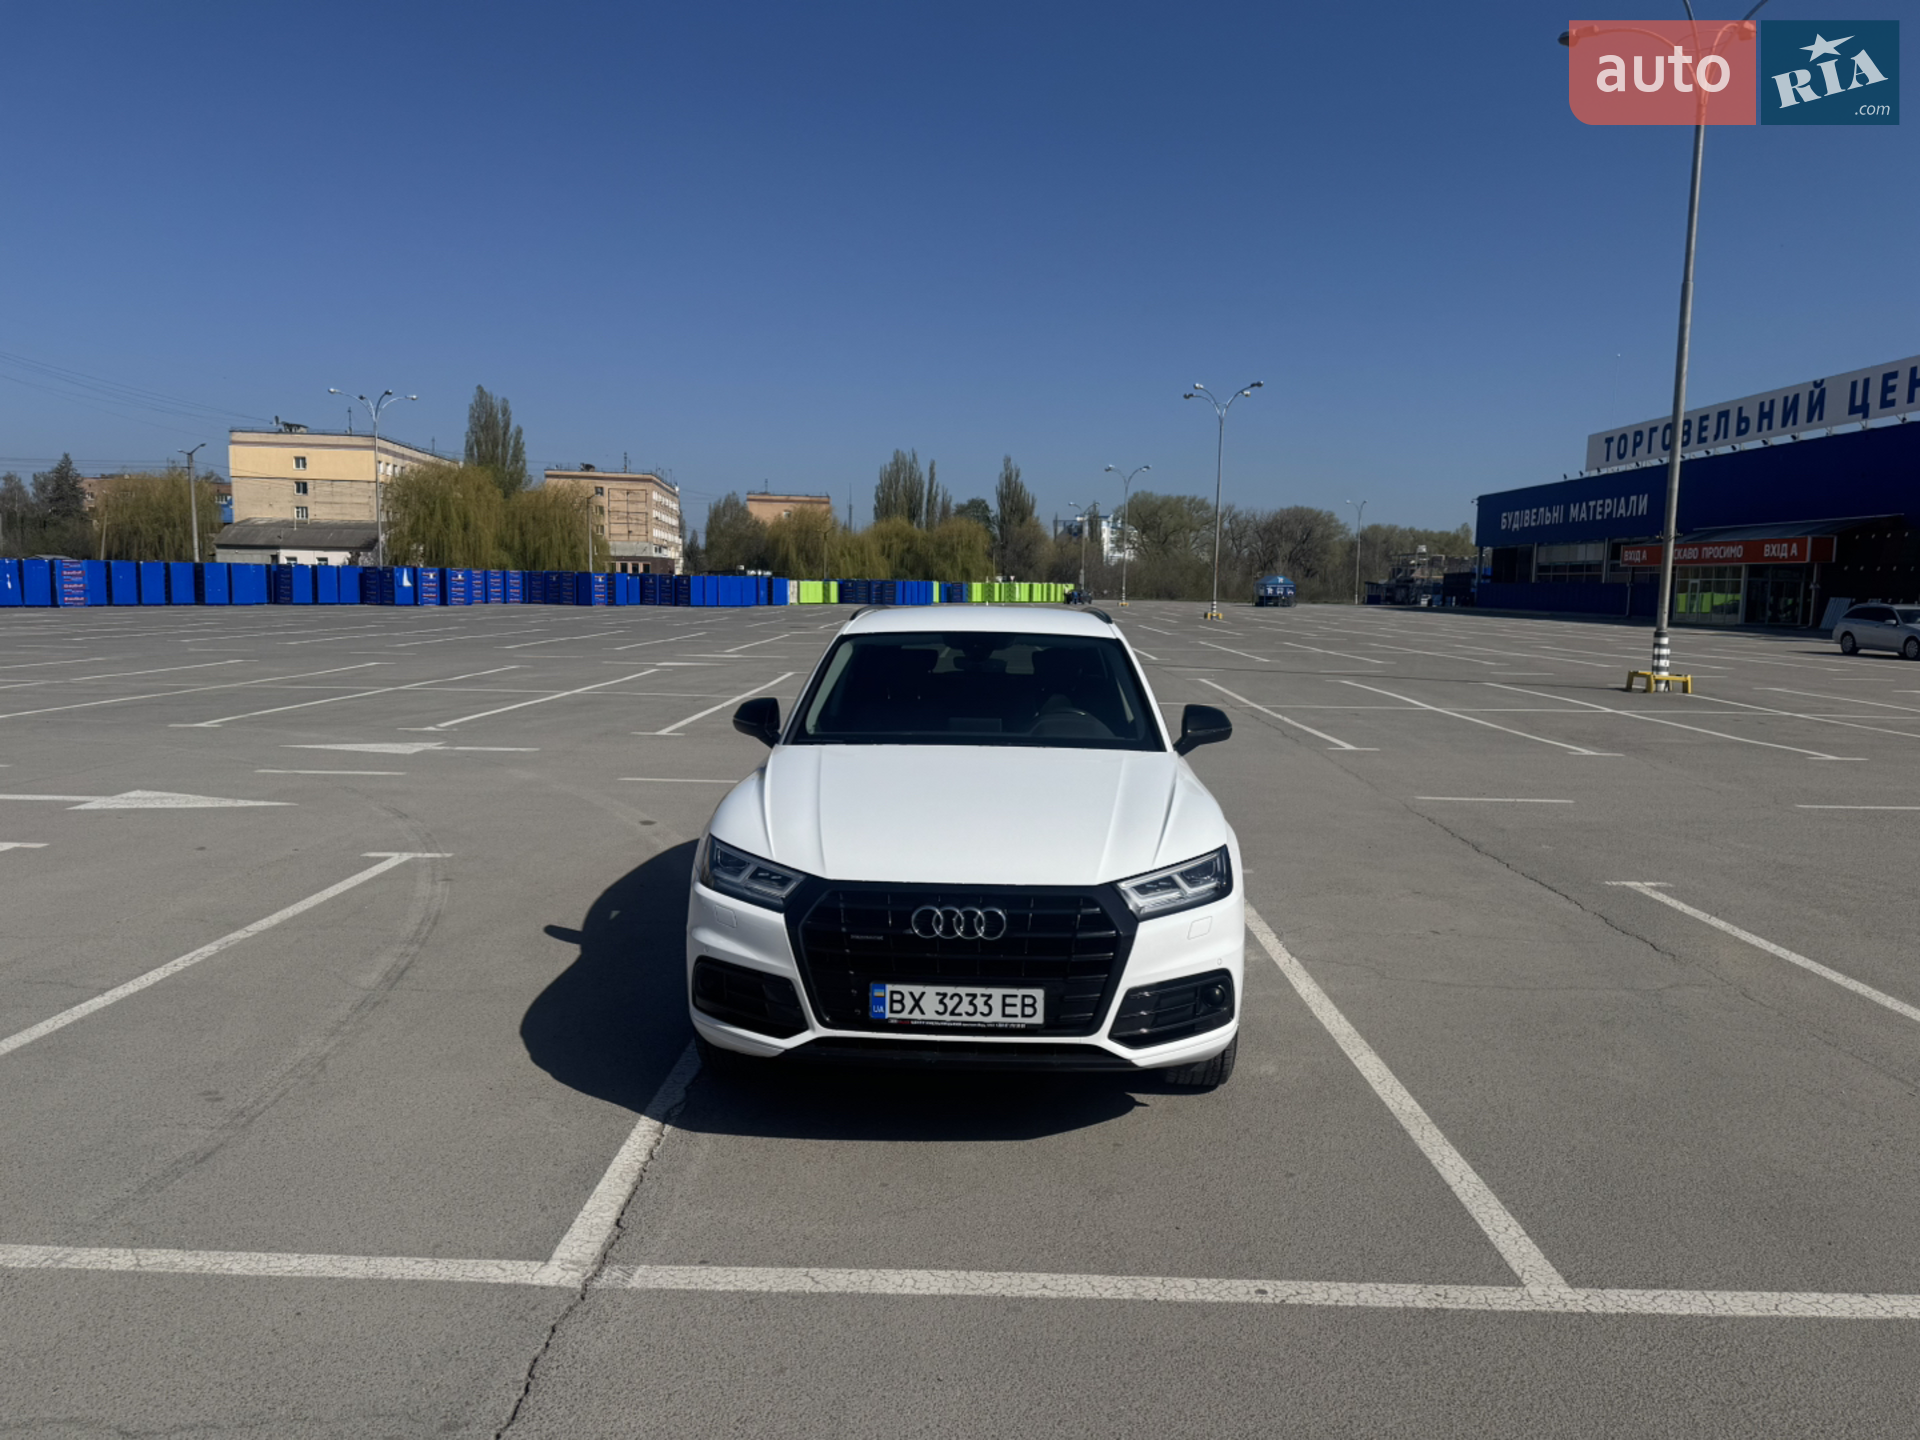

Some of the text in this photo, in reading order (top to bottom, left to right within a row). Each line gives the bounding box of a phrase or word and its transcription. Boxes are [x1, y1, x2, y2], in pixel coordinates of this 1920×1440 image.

[1604, 379, 1827, 462] ТОРГОВЕЛЬНИЙ
[1501, 493, 1649, 532] БУДІВЕЛЬНІ МАТЕРІАЛИ
[1673, 547, 1699, 561] СКАВО
[1701, 545, 1744, 559] ПРОСИМО
[1763, 543, 1788, 558] ВХІД
[1790, 543, 1798, 557] А
[872, 1006, 885, 1014] UA
[889, 990, 1038, 1019] BX 3233 EB
